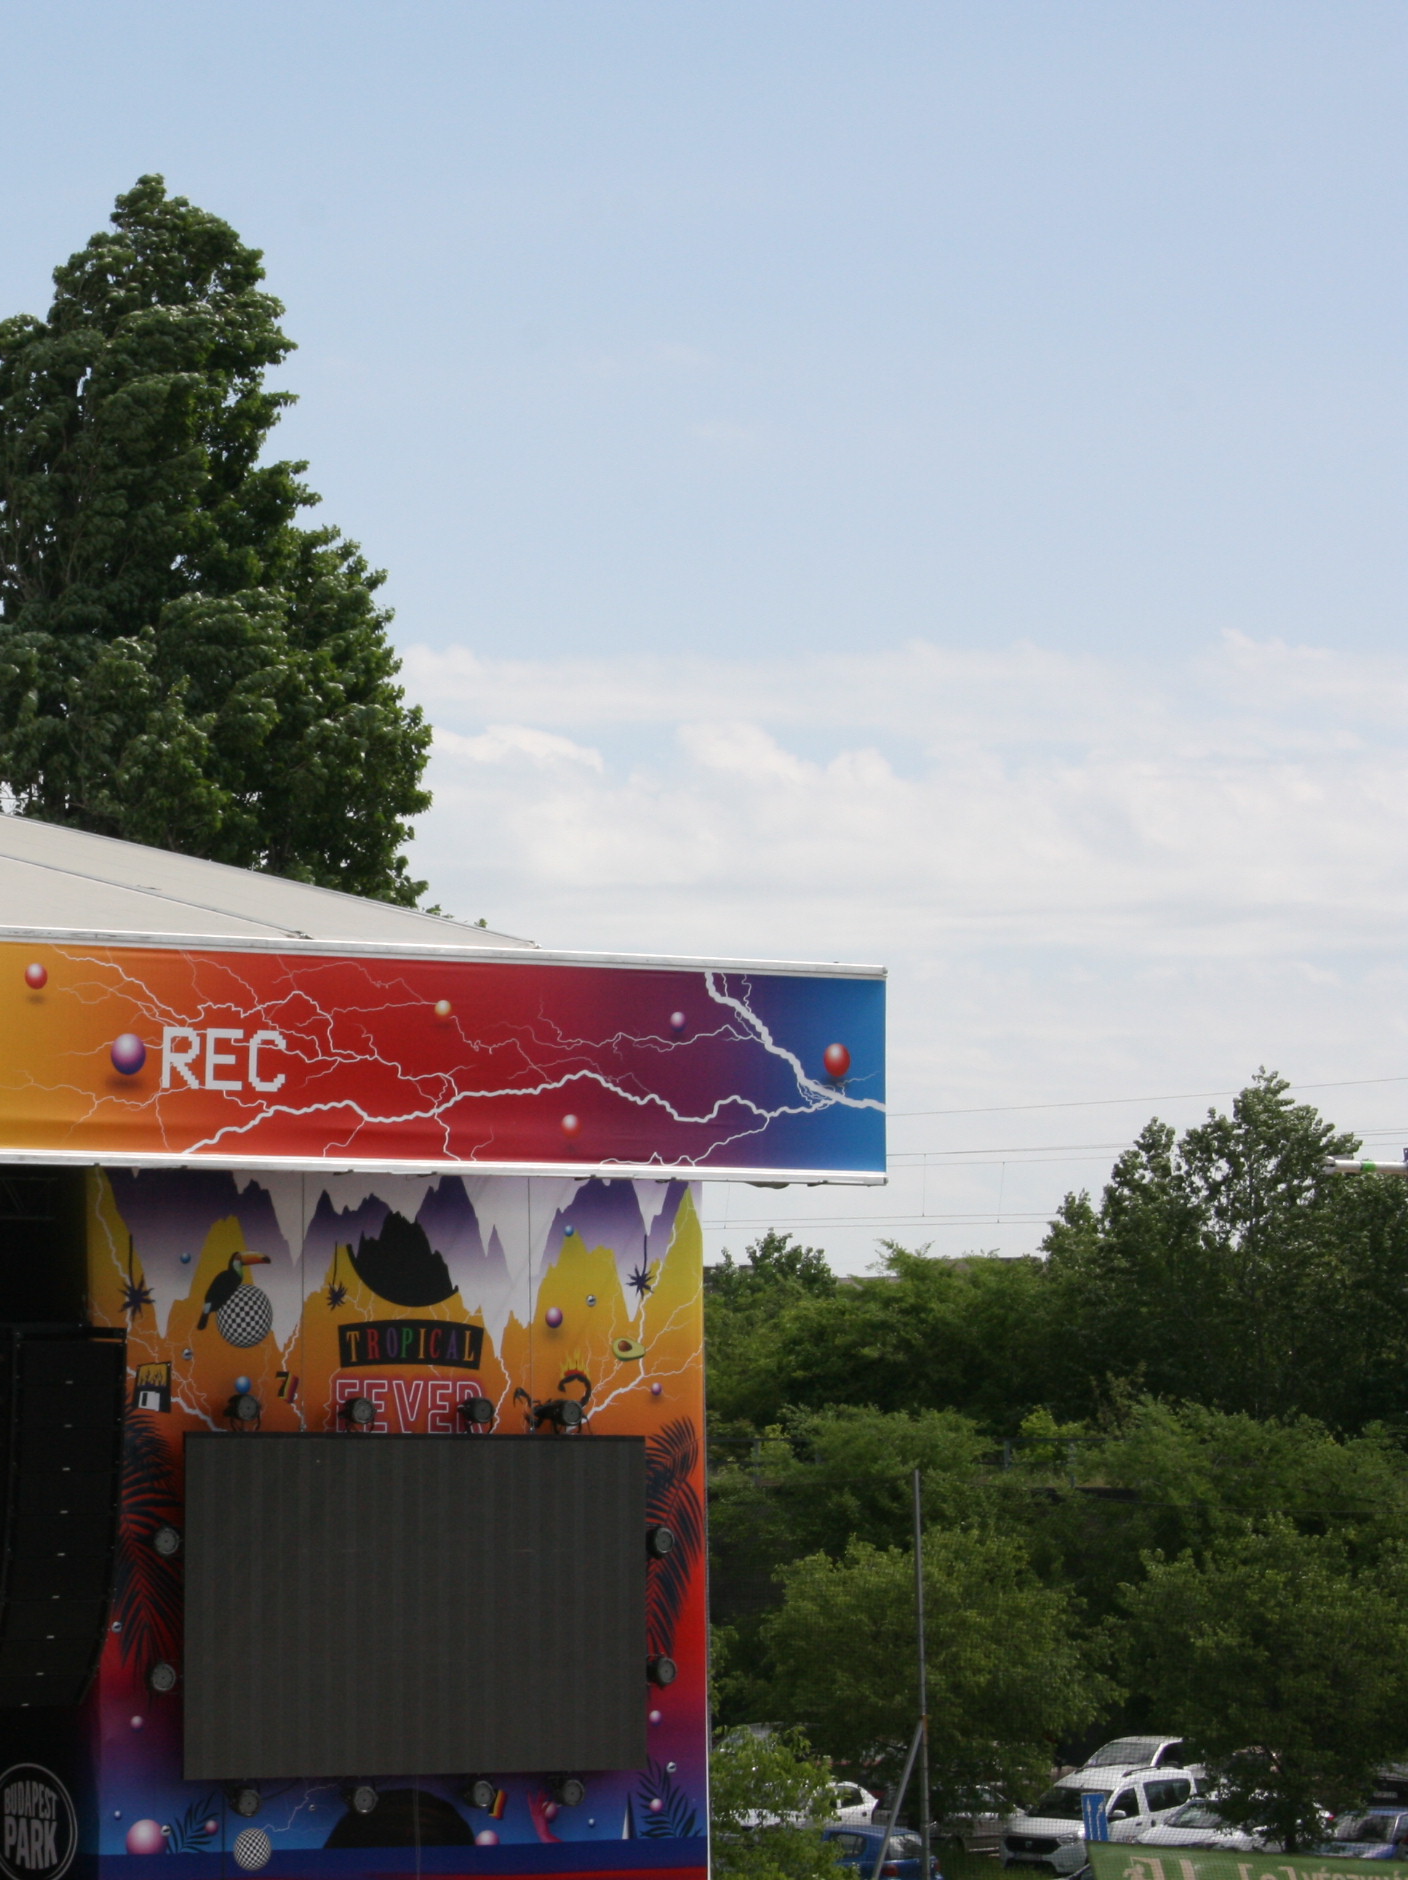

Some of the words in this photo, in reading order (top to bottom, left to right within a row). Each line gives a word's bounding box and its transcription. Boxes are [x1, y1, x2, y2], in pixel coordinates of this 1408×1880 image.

[162, 1026, 286, 1092] REC
[346, 1327, 474, 1362] TROPICAL
[4, 1780, 57, 1820] BUDAPEST
[4, 1816, 58, 1869] PARK
